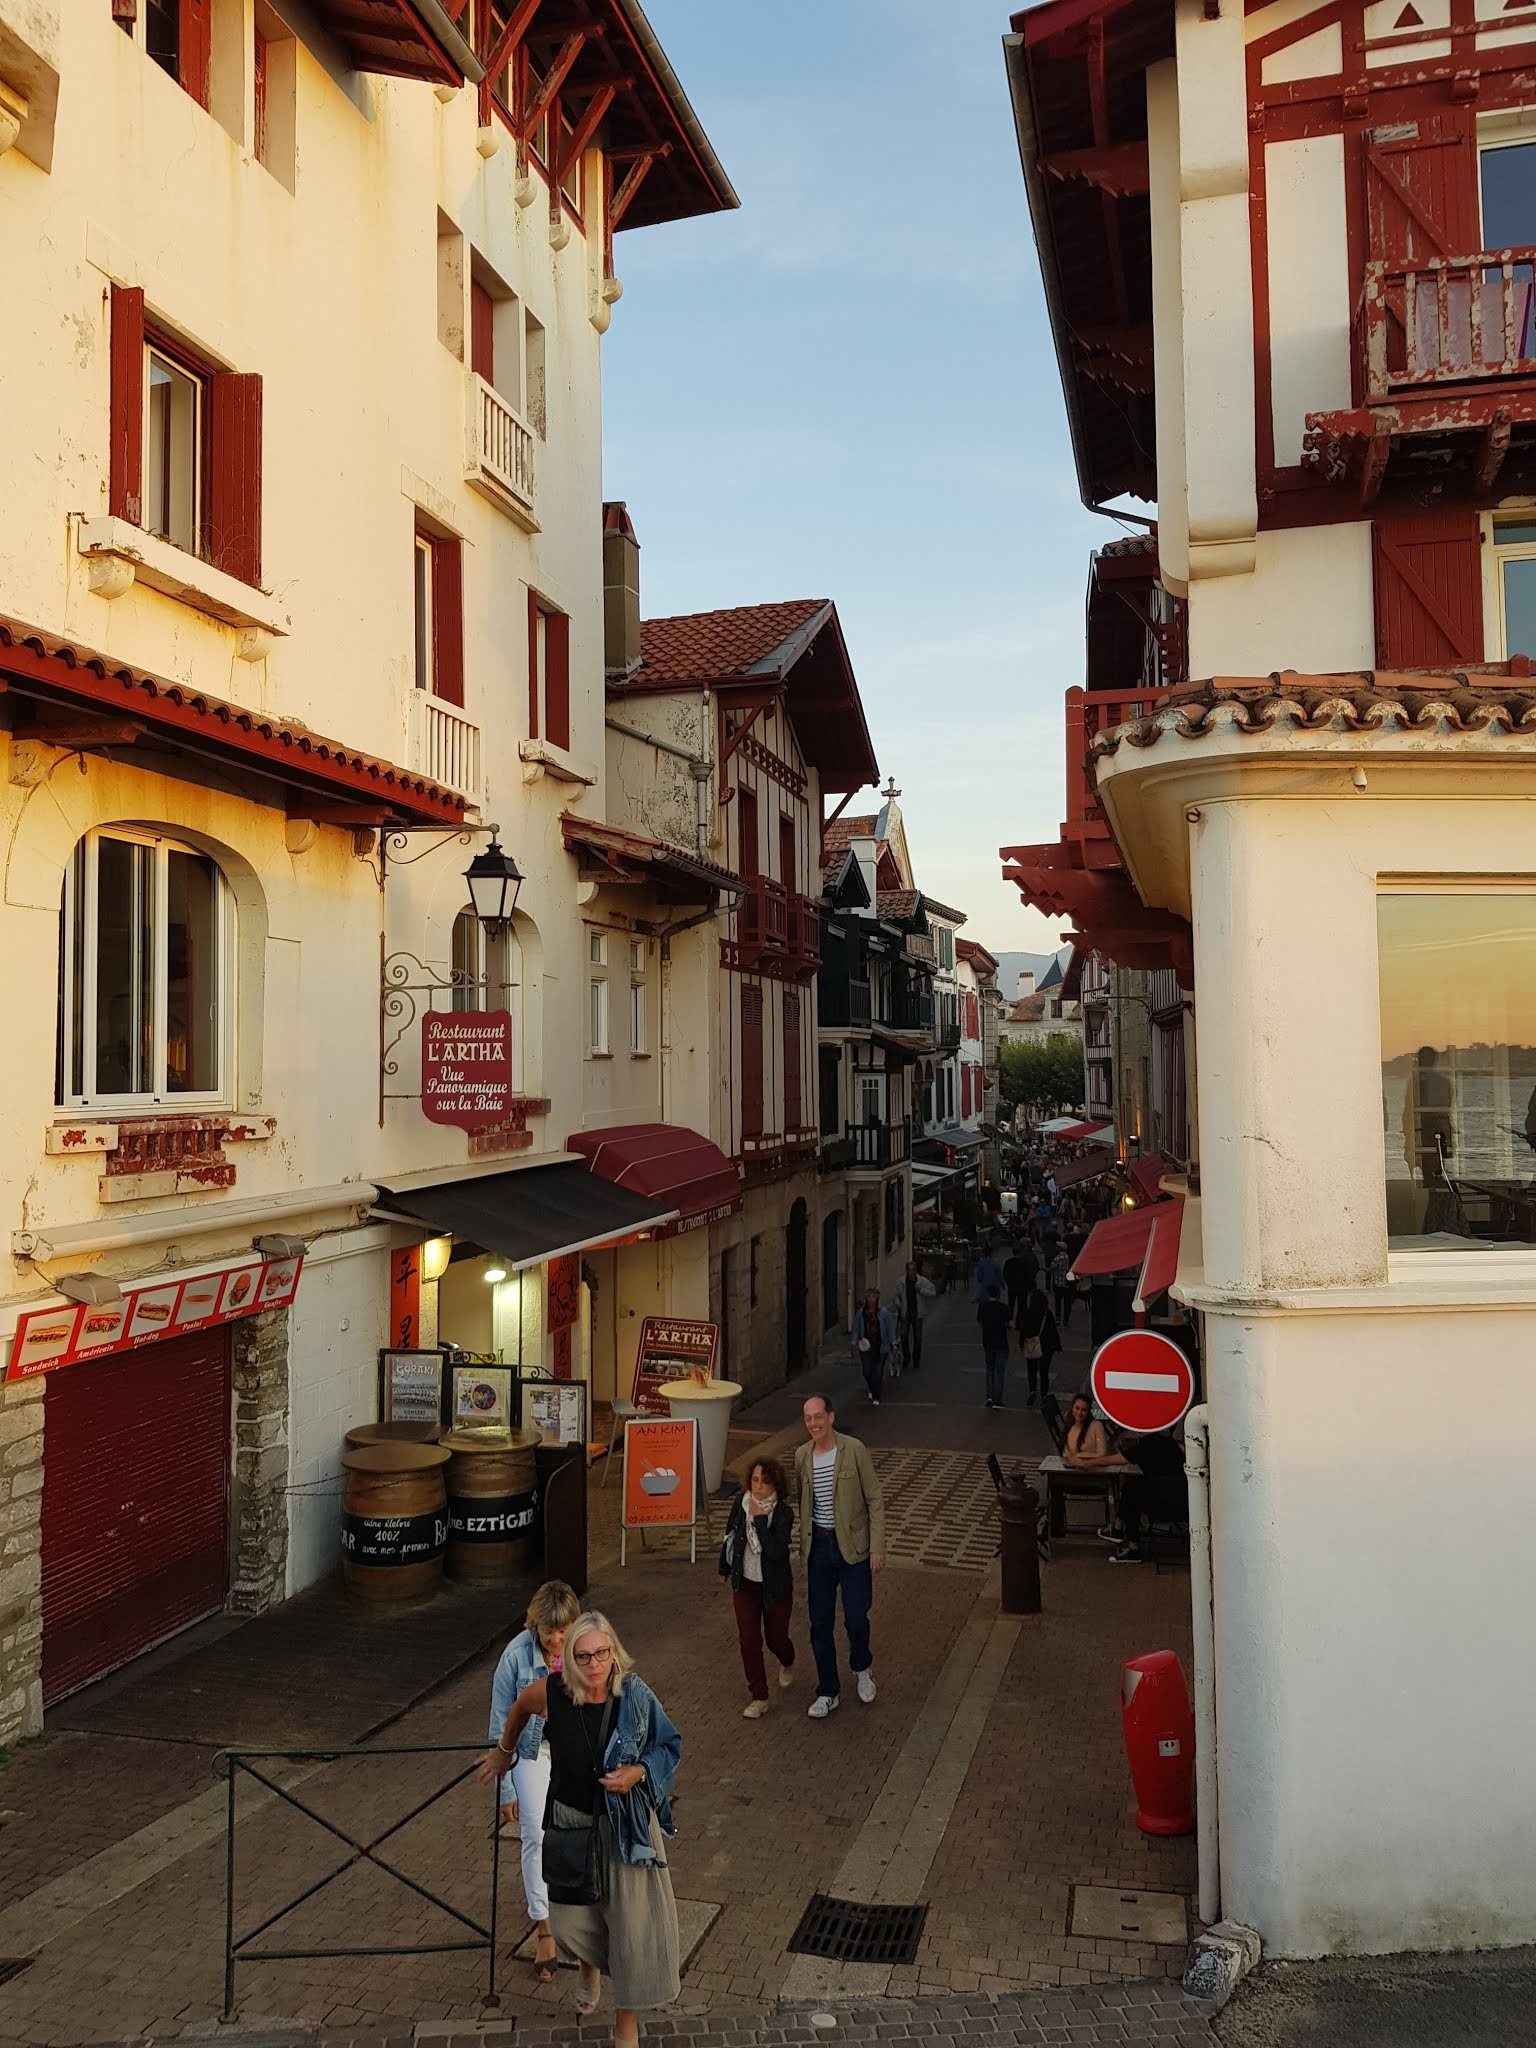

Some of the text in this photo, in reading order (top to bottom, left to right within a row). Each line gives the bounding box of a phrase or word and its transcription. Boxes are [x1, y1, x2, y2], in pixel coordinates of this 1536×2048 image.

[428, 1021, 505, 1039] Restaurant
[427, 1042, 506, 1062] L'ARTHA
[440, 1065, 465, 1081] Vue
[427, 1078, 508, 1098] Panoramique
[436, 1095, 503, 1110] sur la Baie
[654, 1321, 708, 1334] Restaurant
[645, 1329, 713, 1346] L'ARTHA
[21, 1358, 59, 1375] Sandwich
[76, 1344, 115, 1360] Américain
[635, 1425, 686, 1436] AN KIM
[374, 1529, 400, 1542] 100%
[361, 1545, 378, 1555] avec
